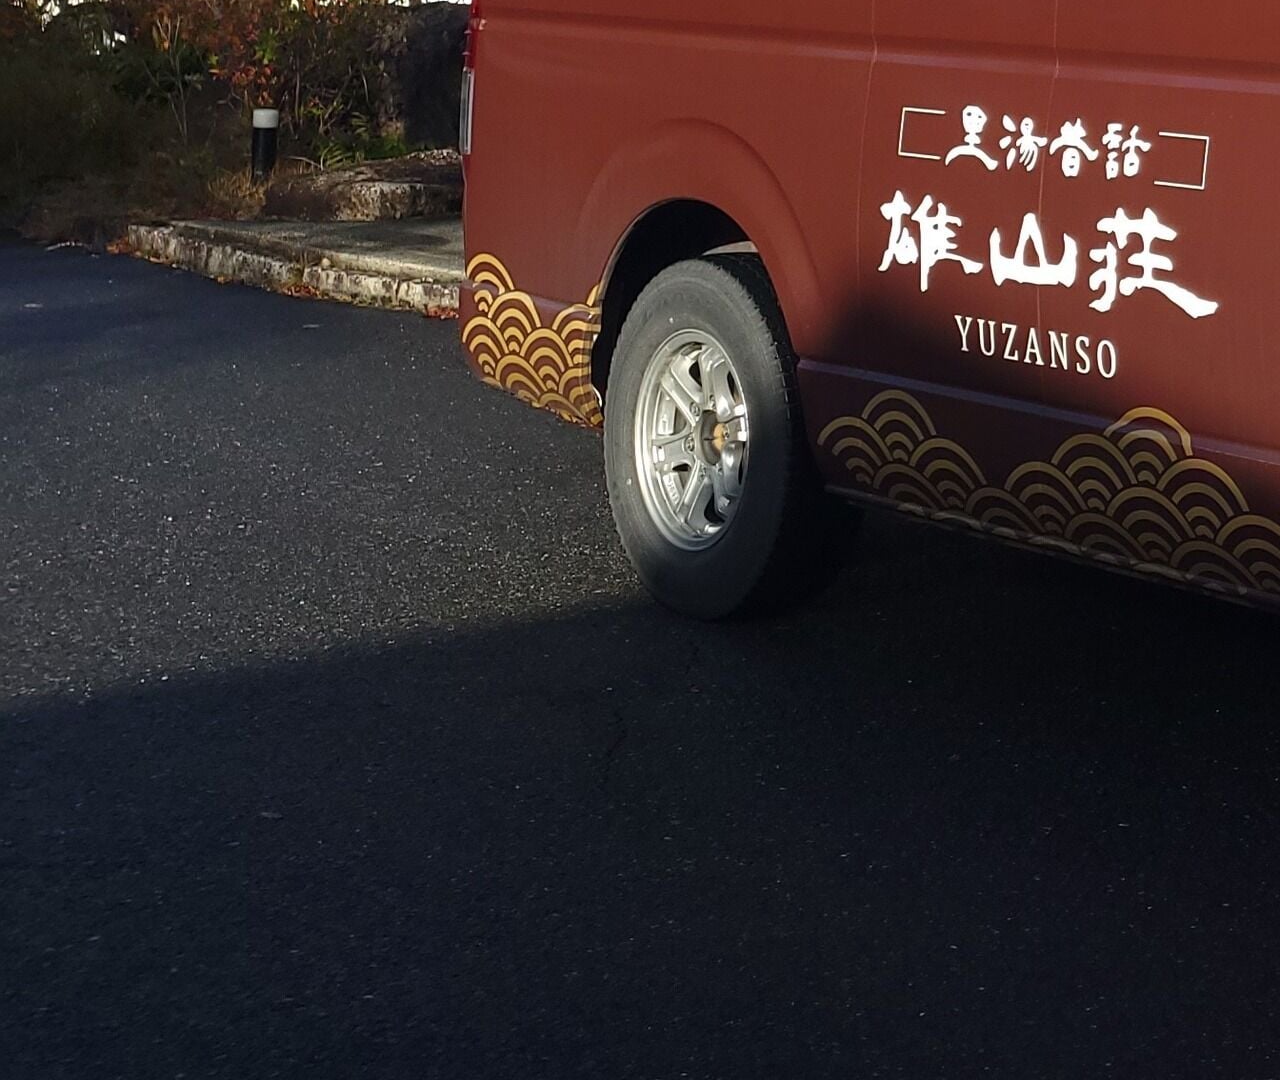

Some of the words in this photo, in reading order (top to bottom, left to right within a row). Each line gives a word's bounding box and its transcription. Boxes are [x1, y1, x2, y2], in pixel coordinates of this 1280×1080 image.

[878, 190, 1219, 319] 雄山荘
[954, 314, 1117, 378] YUZANSO
